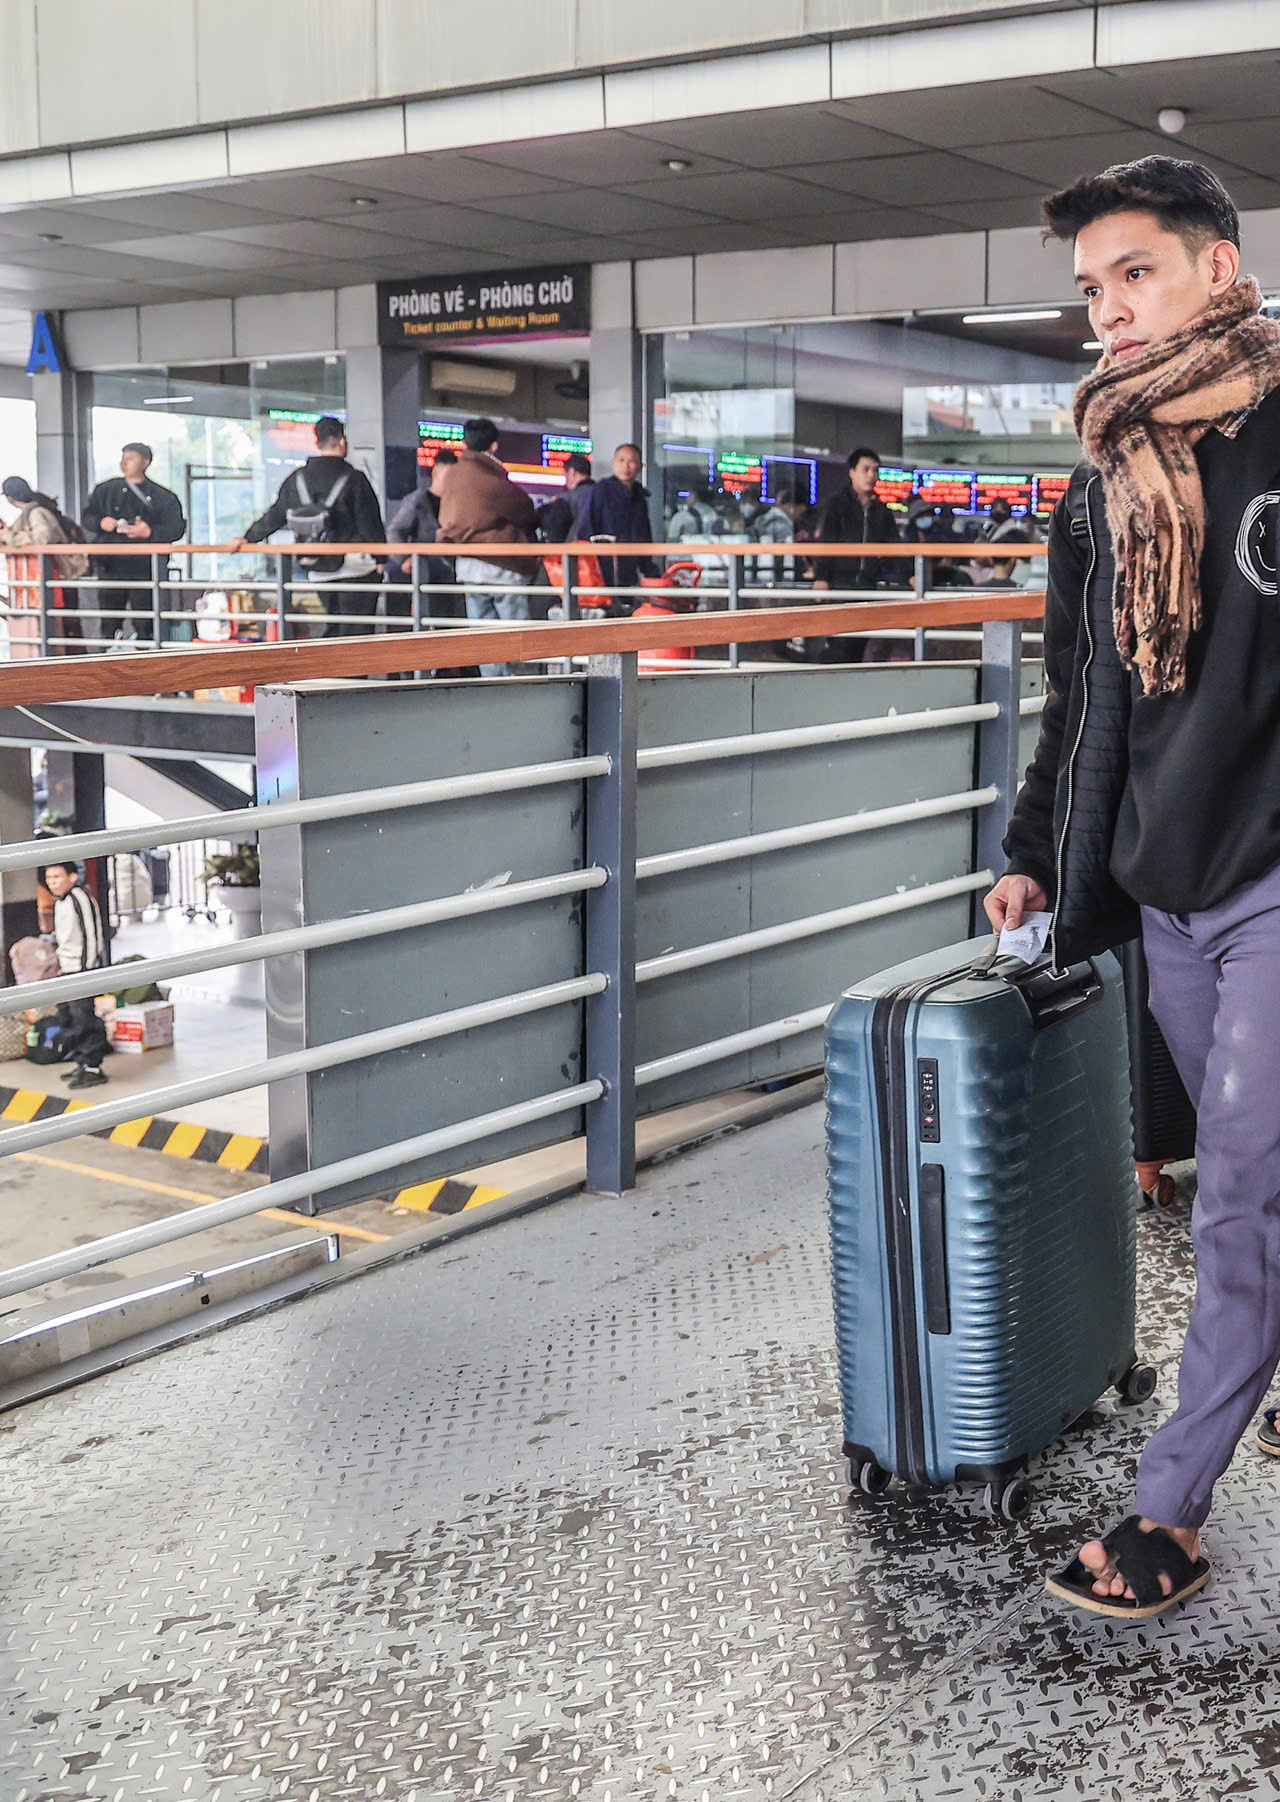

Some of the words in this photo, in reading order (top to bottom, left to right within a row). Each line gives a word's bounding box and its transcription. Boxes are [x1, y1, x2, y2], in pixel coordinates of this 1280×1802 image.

[388, 289, 441, 318] PHÒNG
[443, 284, 465, 314] VÉ
[479, 280, 535, 312] PHÒNG
[538, 274, 574, 306] CHỜ
[25, 311, 62, 374] A
